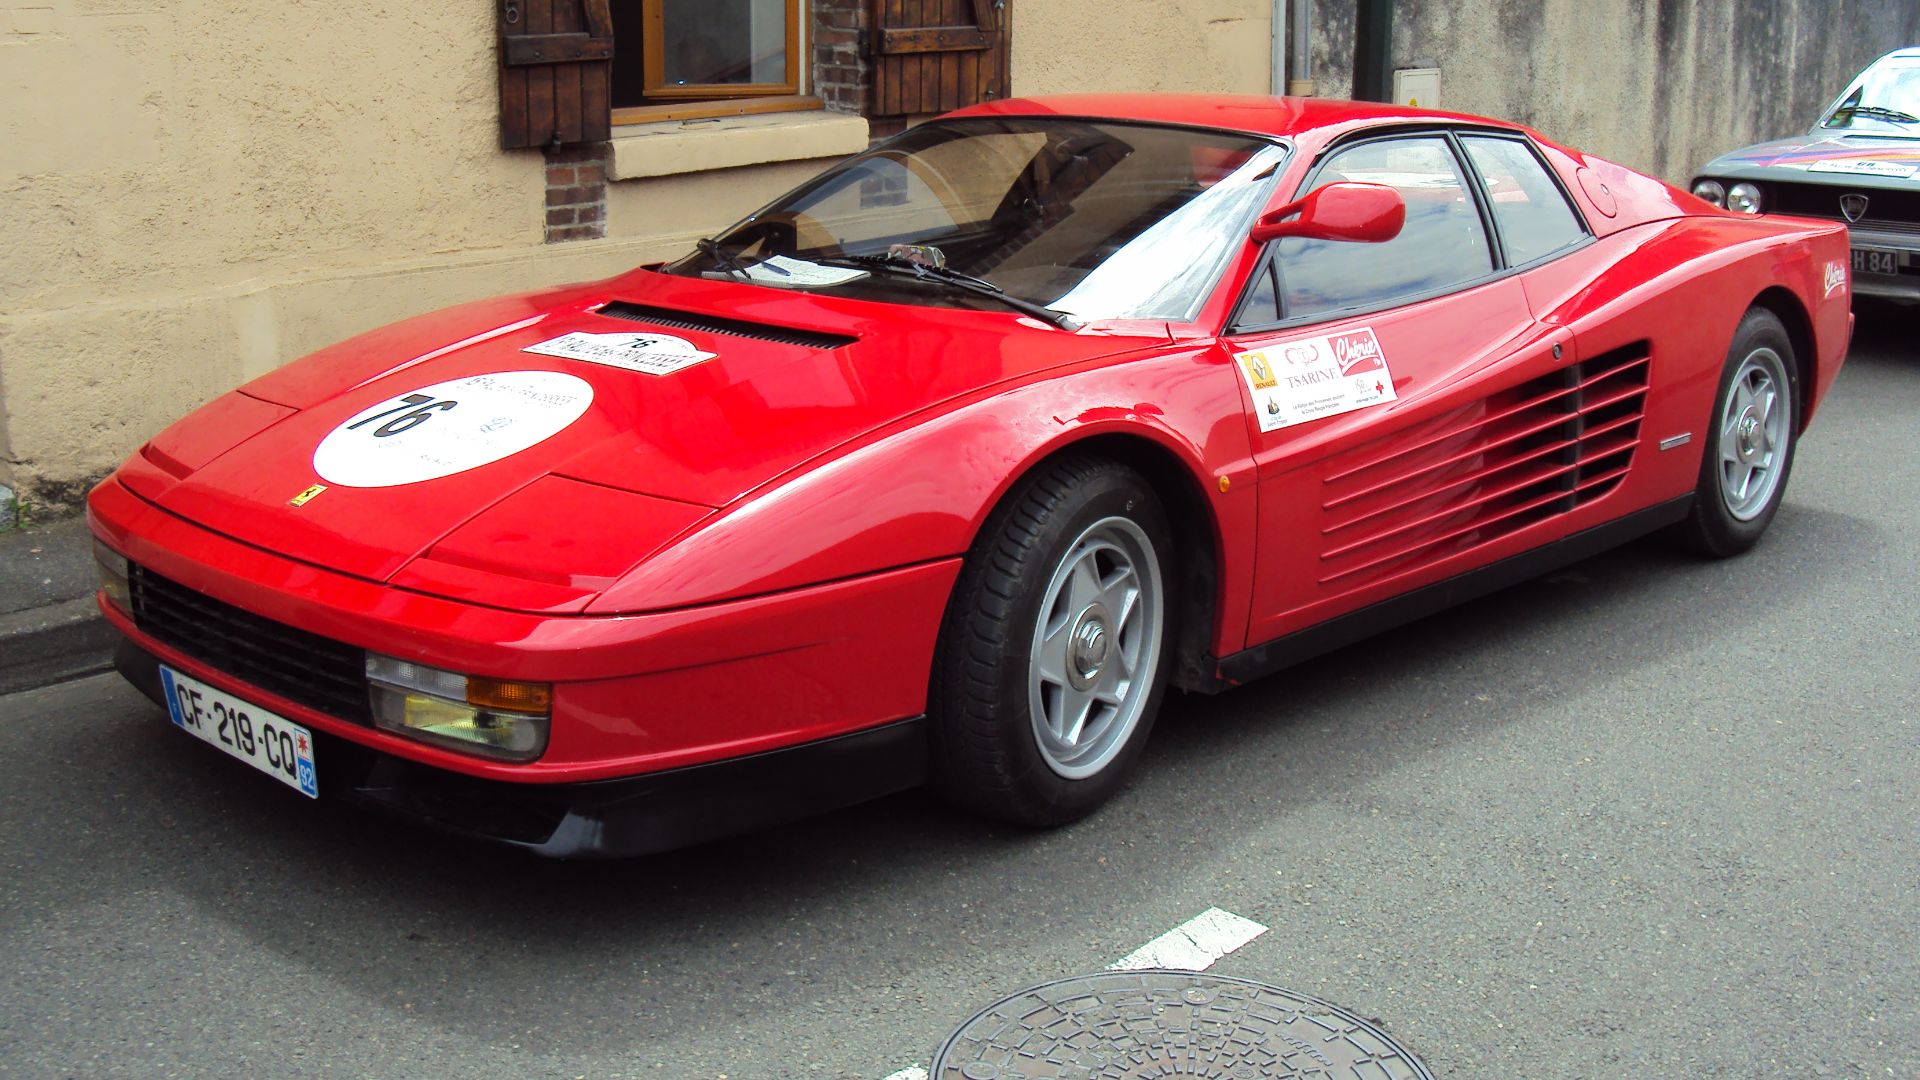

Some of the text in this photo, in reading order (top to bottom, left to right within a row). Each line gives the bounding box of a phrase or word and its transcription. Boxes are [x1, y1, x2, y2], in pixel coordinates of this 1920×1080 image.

[1869, 252, 1894, 273] 84
[618, 337, 658, 349] 76
[1335, 336, 1377, 367] Chérie
[1255, 380, 1277, 390] RENAULT
[1285, 368, 1338, 388] TSARINE
[347, 393, 458, 437] 76
[300, 764, 315, 789] 92
